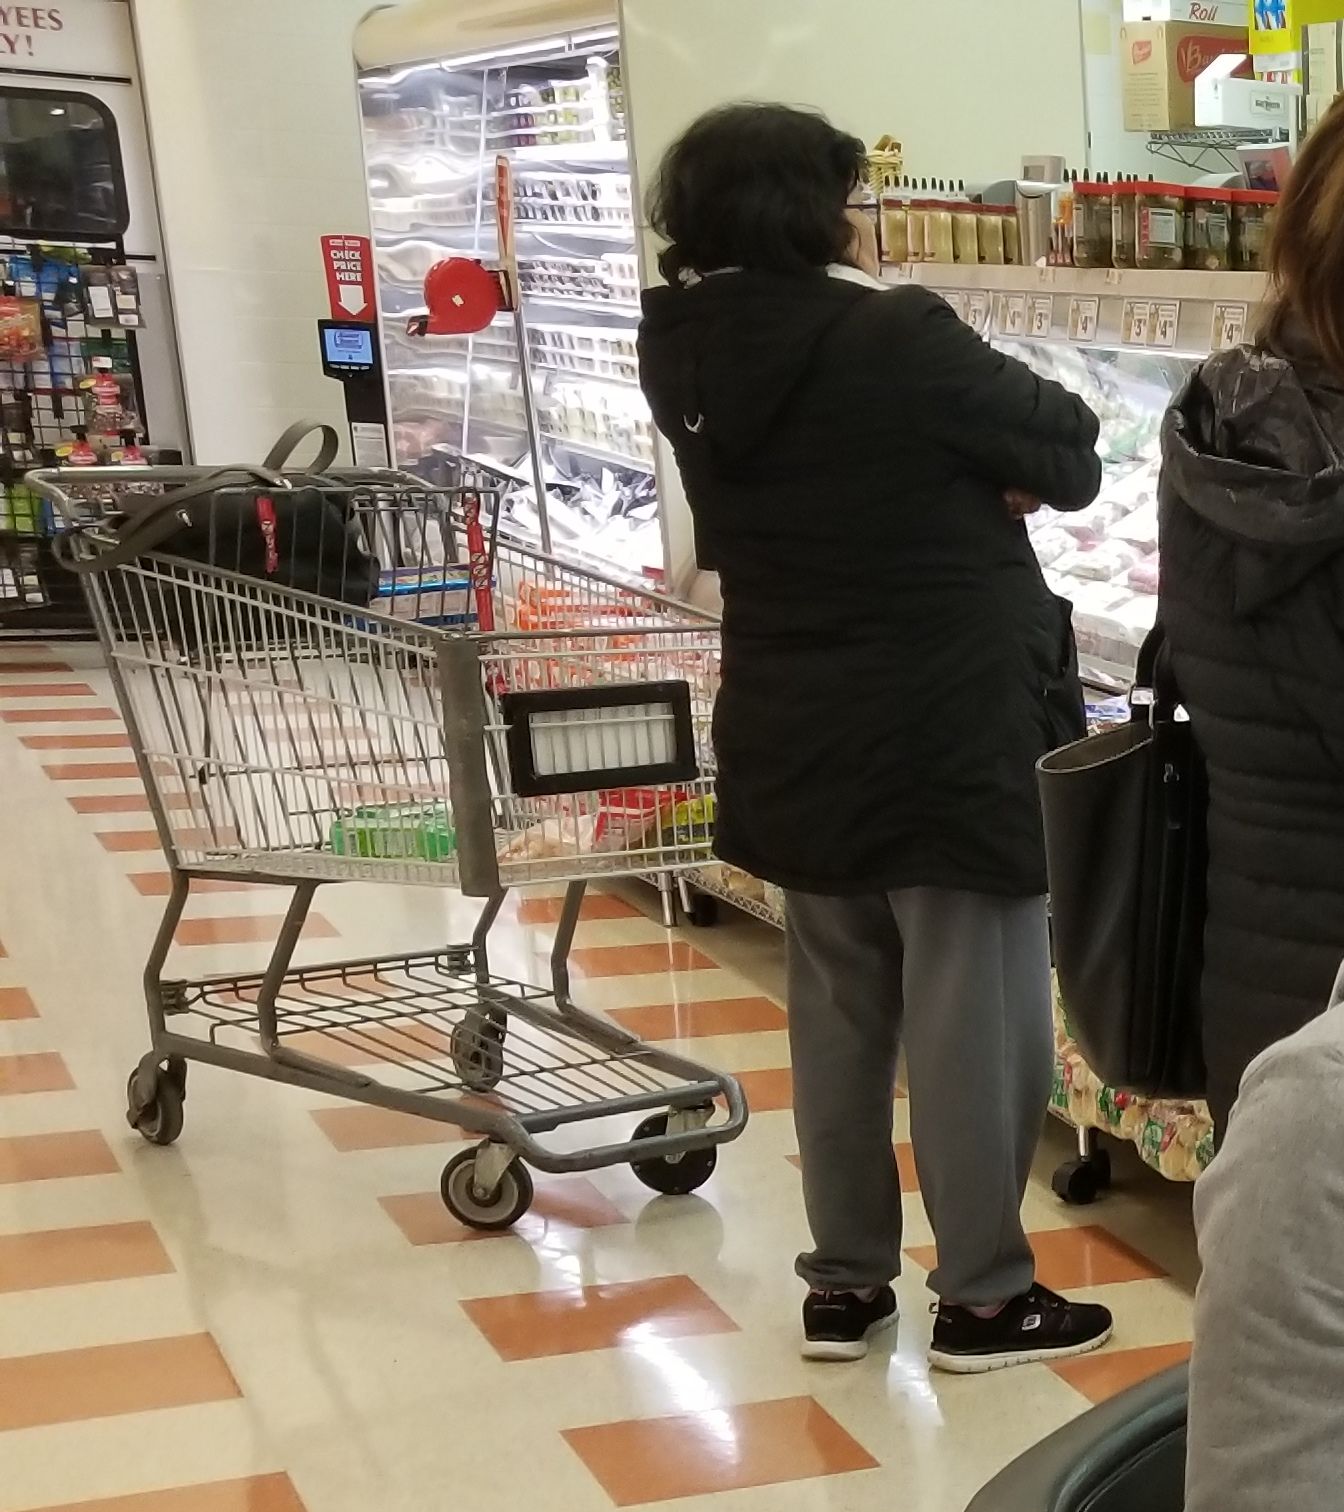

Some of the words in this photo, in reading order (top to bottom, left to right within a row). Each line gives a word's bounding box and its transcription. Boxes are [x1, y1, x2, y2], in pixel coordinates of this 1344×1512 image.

[1189, 2, 1218, 21] Roll
[331, 250, 362, 260] CHECK
[333, 261, 362, 270] PRICE
[335, 272, 362, 281] HERE
